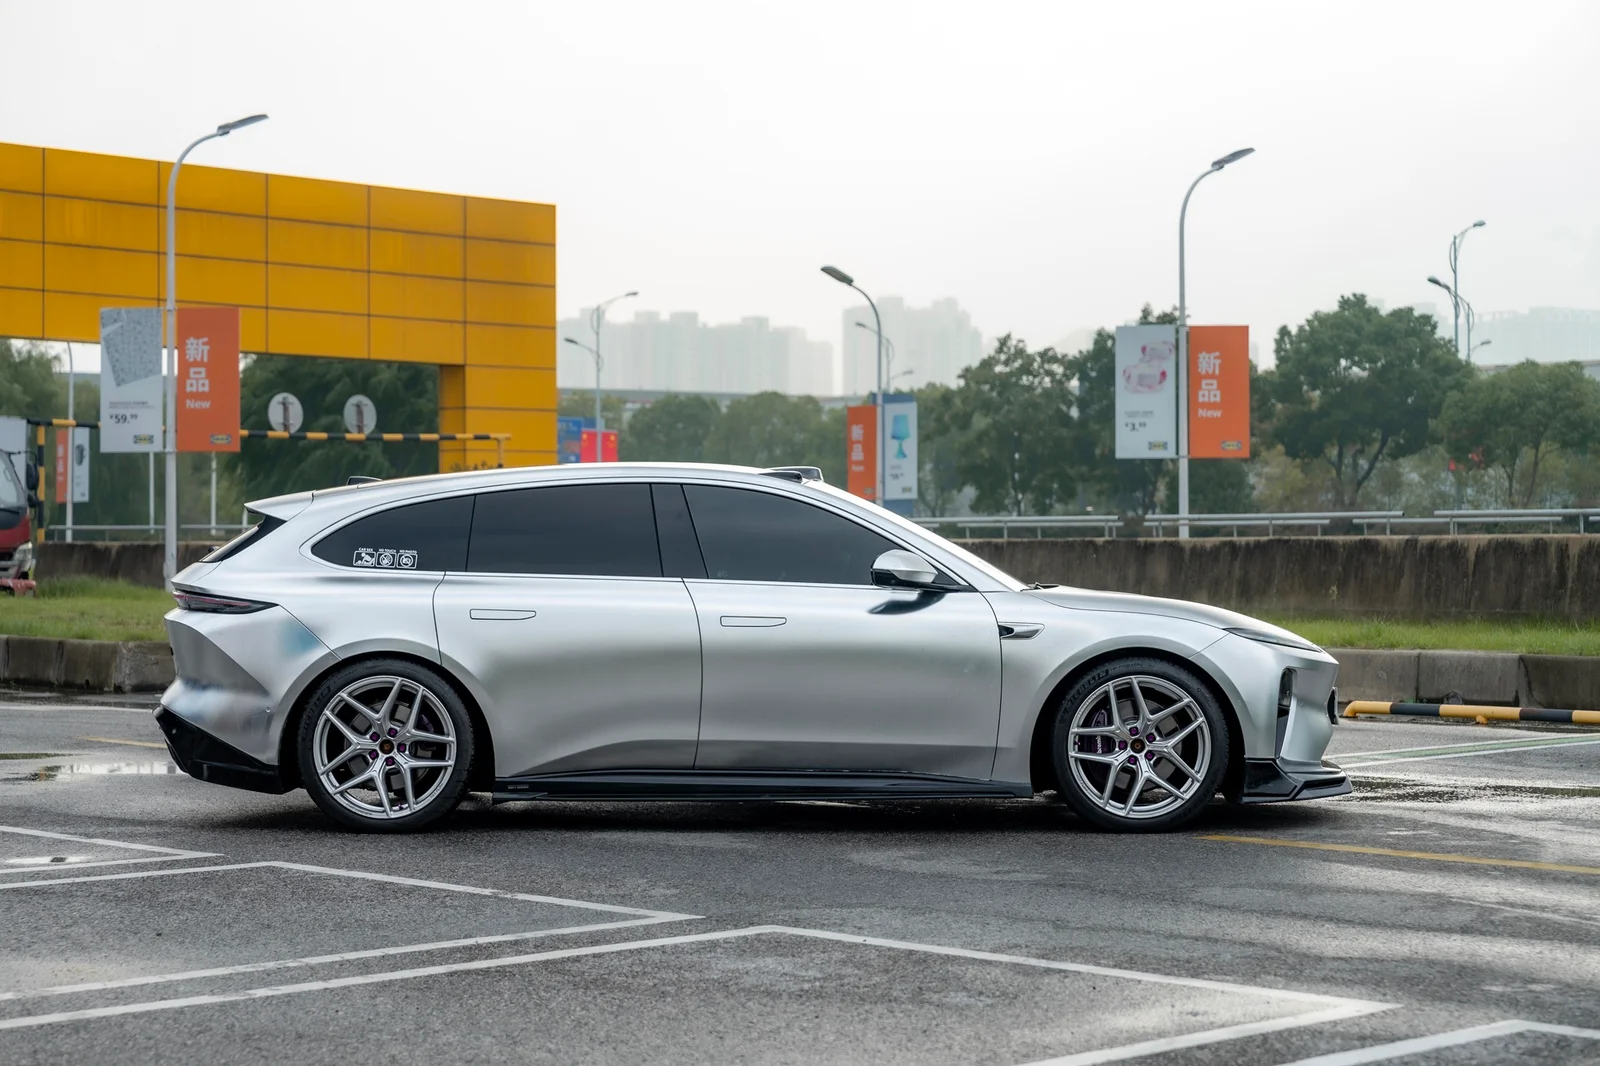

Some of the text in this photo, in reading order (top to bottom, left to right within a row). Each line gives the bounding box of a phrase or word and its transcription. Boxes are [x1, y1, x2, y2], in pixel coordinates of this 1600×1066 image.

[185, 336, 210, 393] 新品
[1198, 351, 1222, 403] 新品
[185, 399, 211, 409] New
[1198, 408, 1222, 418] New
